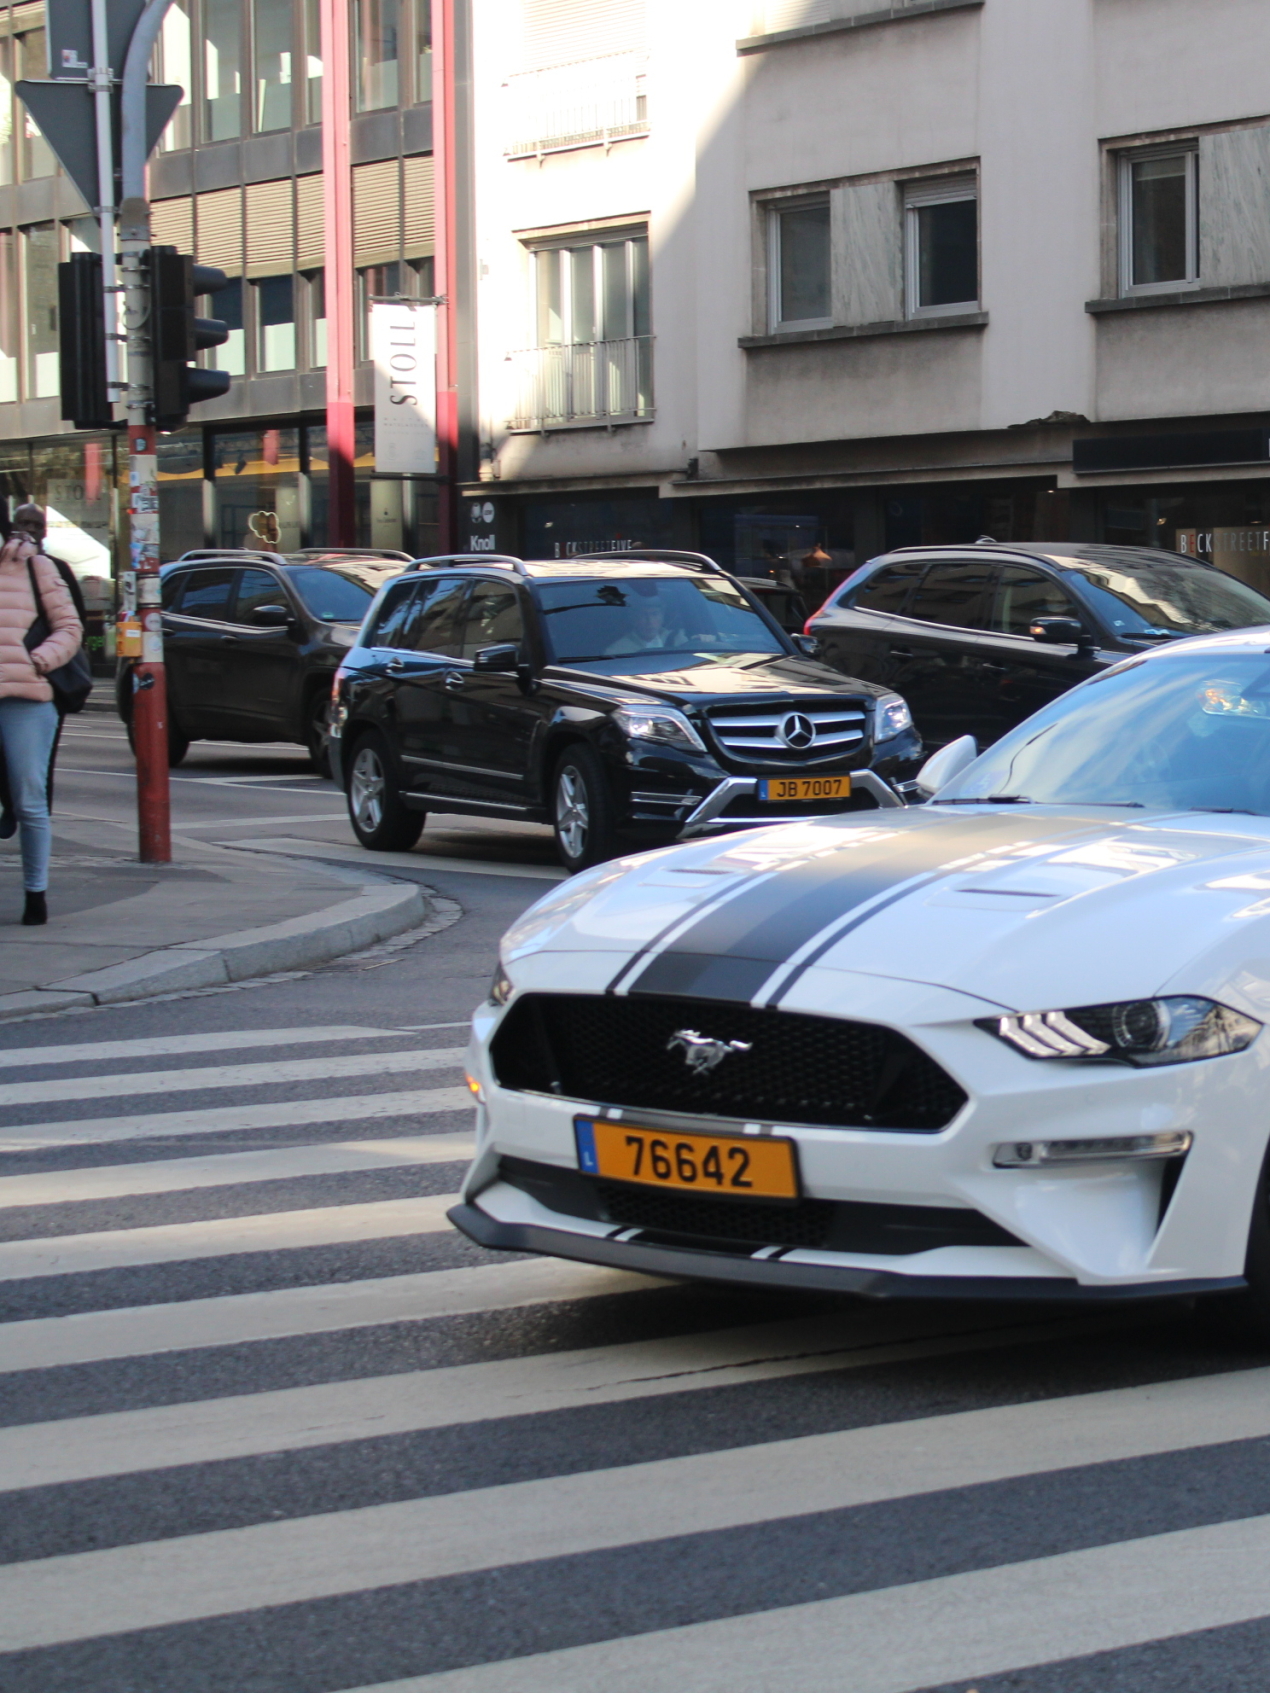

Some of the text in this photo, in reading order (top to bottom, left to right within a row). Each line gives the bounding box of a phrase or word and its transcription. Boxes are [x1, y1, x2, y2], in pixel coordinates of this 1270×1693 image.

[389, 321, 417, 405] STOLL
[470, 534, 495, 551] Knoll
[777, 779, 842, 797] JB 7007
[625, 1135, 753, 1188] 76642
